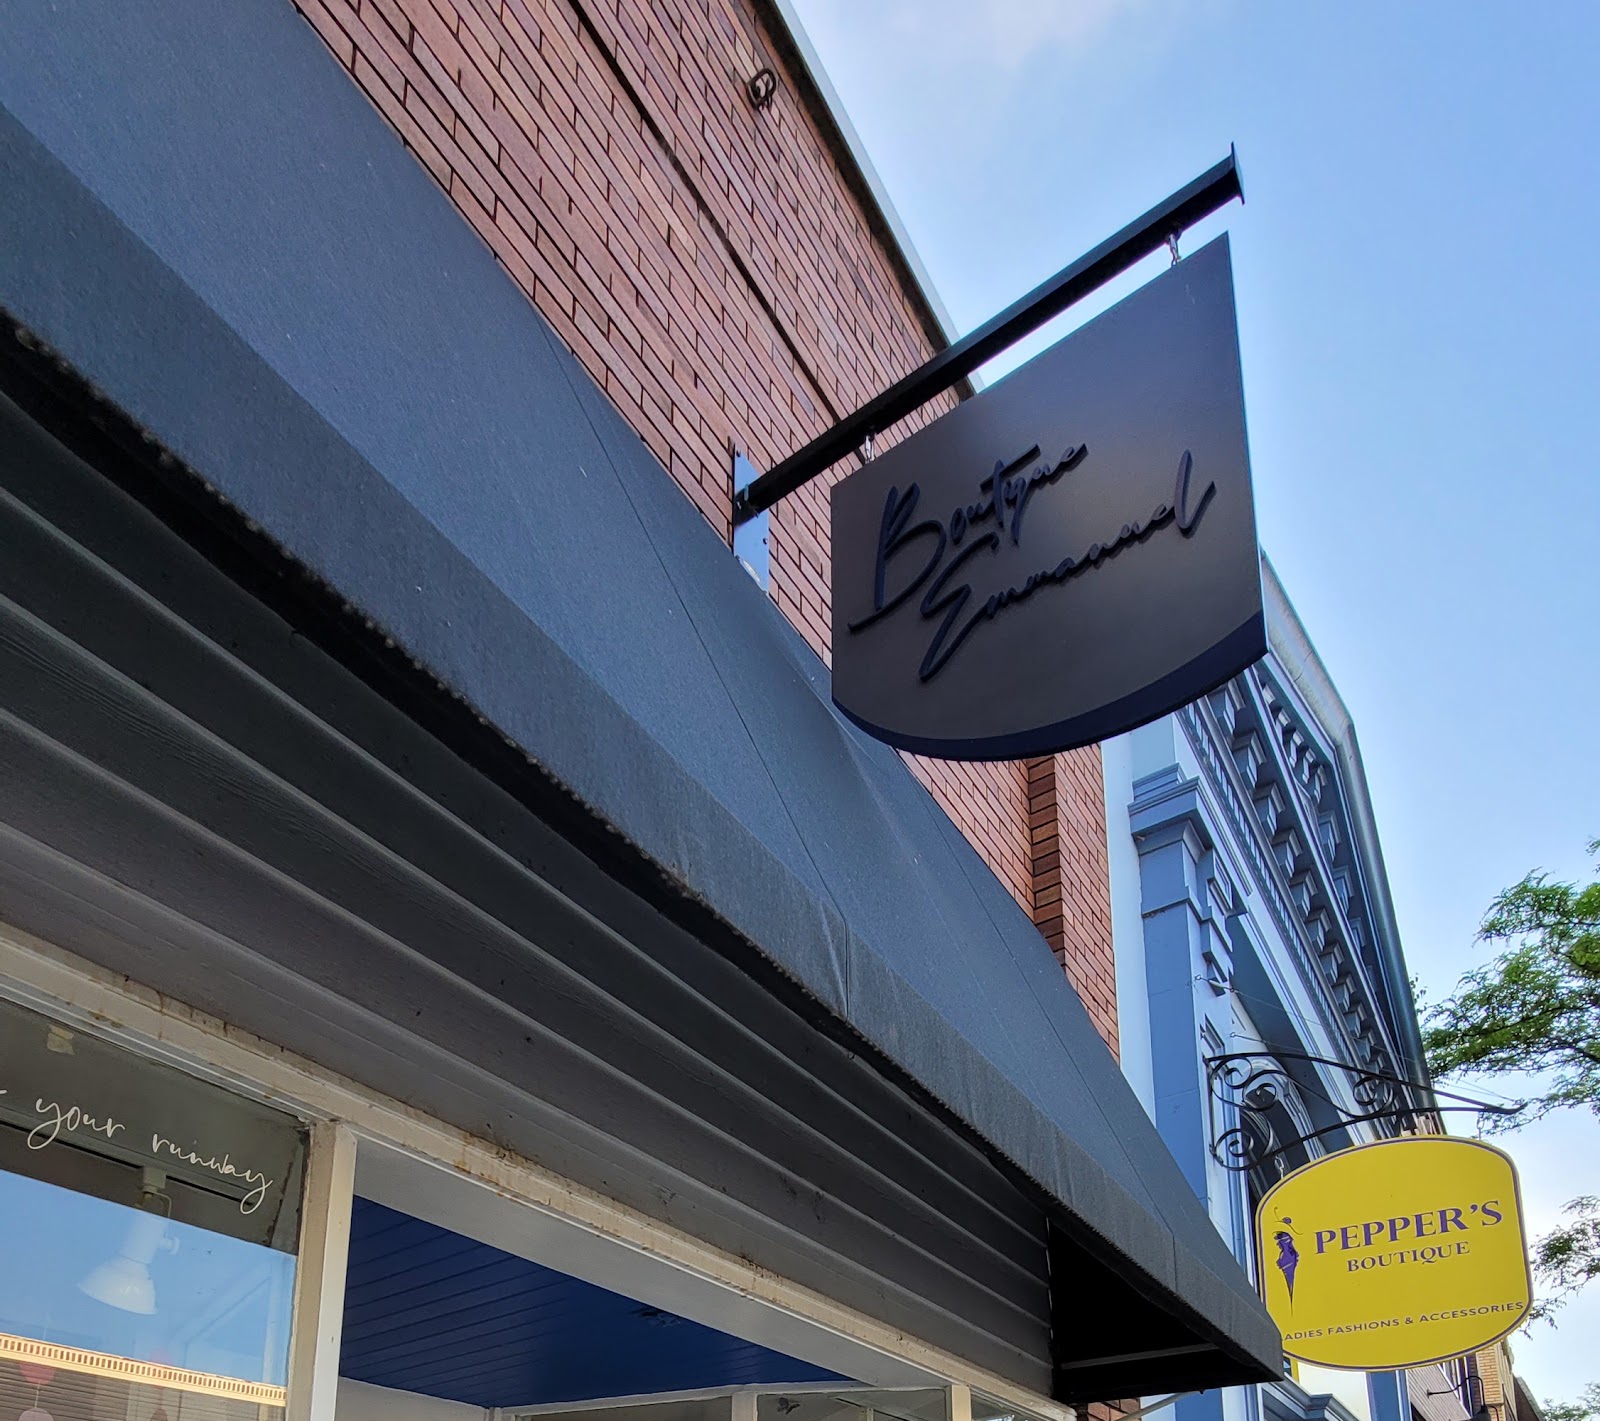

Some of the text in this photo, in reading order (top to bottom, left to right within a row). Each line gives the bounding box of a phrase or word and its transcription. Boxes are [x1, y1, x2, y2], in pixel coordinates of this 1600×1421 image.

[27, 1098, 125, 1150] your
[1314, 1199, 1504, 1255] PEPPER'S
[1346, 1240, 1470, 1273] BOUTIQUE
[1281, 1301, 1524, 1342] ADIES FASHIONS & ACCESSORIES
